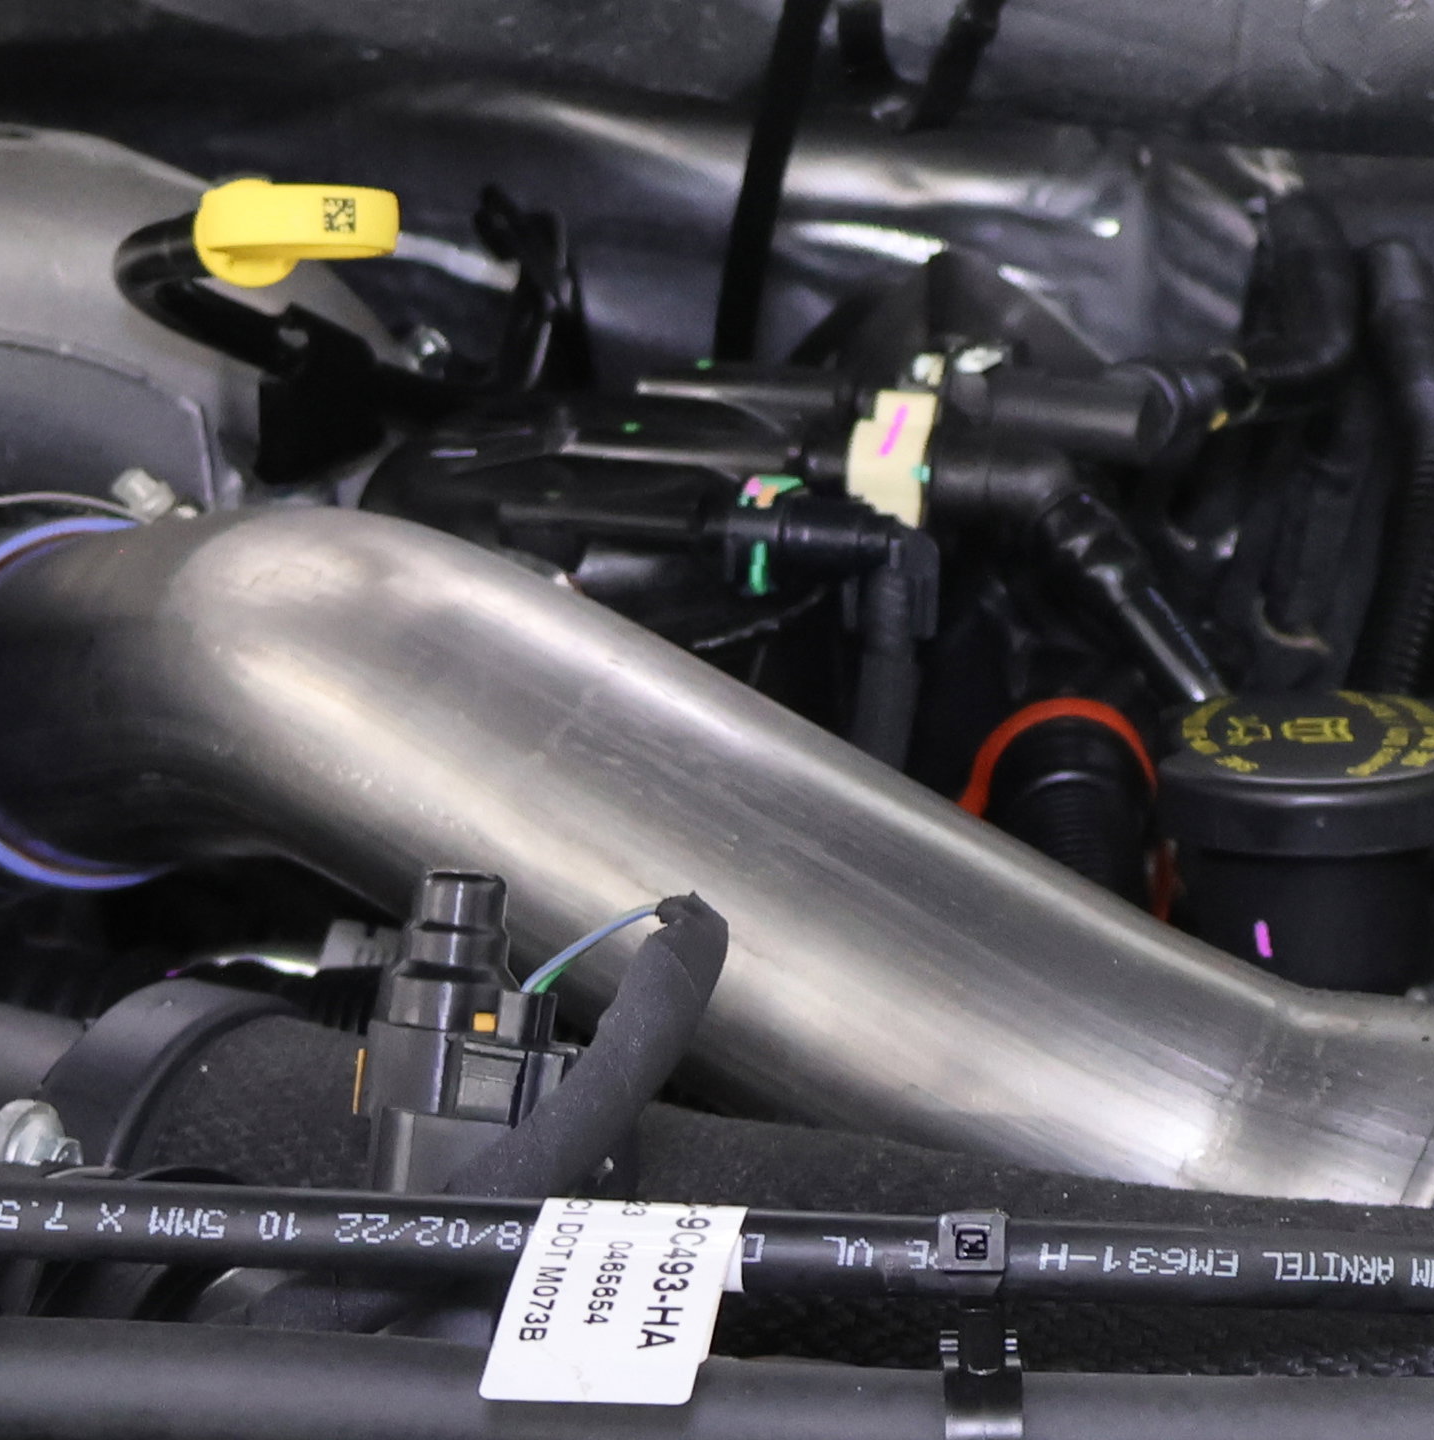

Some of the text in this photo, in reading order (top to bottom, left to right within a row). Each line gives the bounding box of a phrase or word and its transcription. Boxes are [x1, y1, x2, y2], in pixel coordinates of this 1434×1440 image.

[96, 1202, 127, 1233] X
[332, 1211, 532, 1252] 8/02/22
[545, 1222, 585, 1260] DOT
[1038, 1242, 1239, 1278] EM631-H
[636, 1203, 713, 1350] -9C493-HA
[1261, 1250, 1395, 1286] ARNITEL
[518, 1265, 567, 1342] M073B
